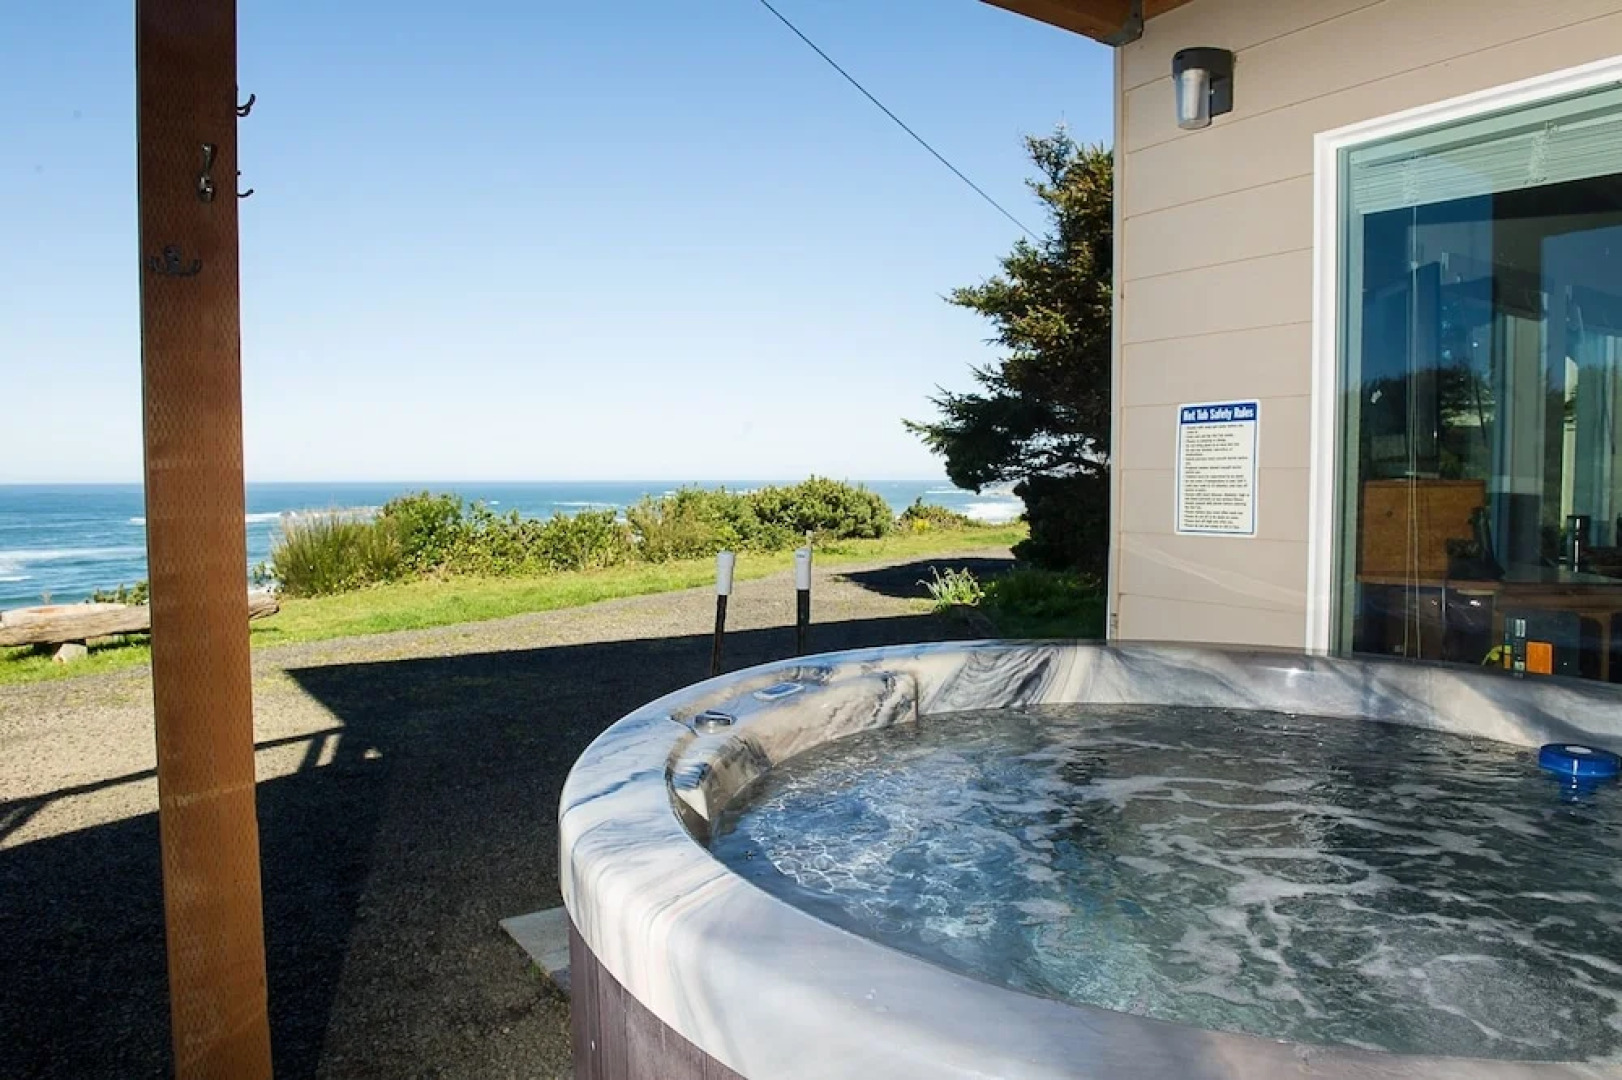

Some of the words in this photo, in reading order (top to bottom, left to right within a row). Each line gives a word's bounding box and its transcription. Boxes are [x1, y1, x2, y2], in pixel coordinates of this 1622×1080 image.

[1183, 409, 1196, 420] Hot
[1209, 407, 1232, 421] Safety
[1233, 406, 1254, 418] Rules
